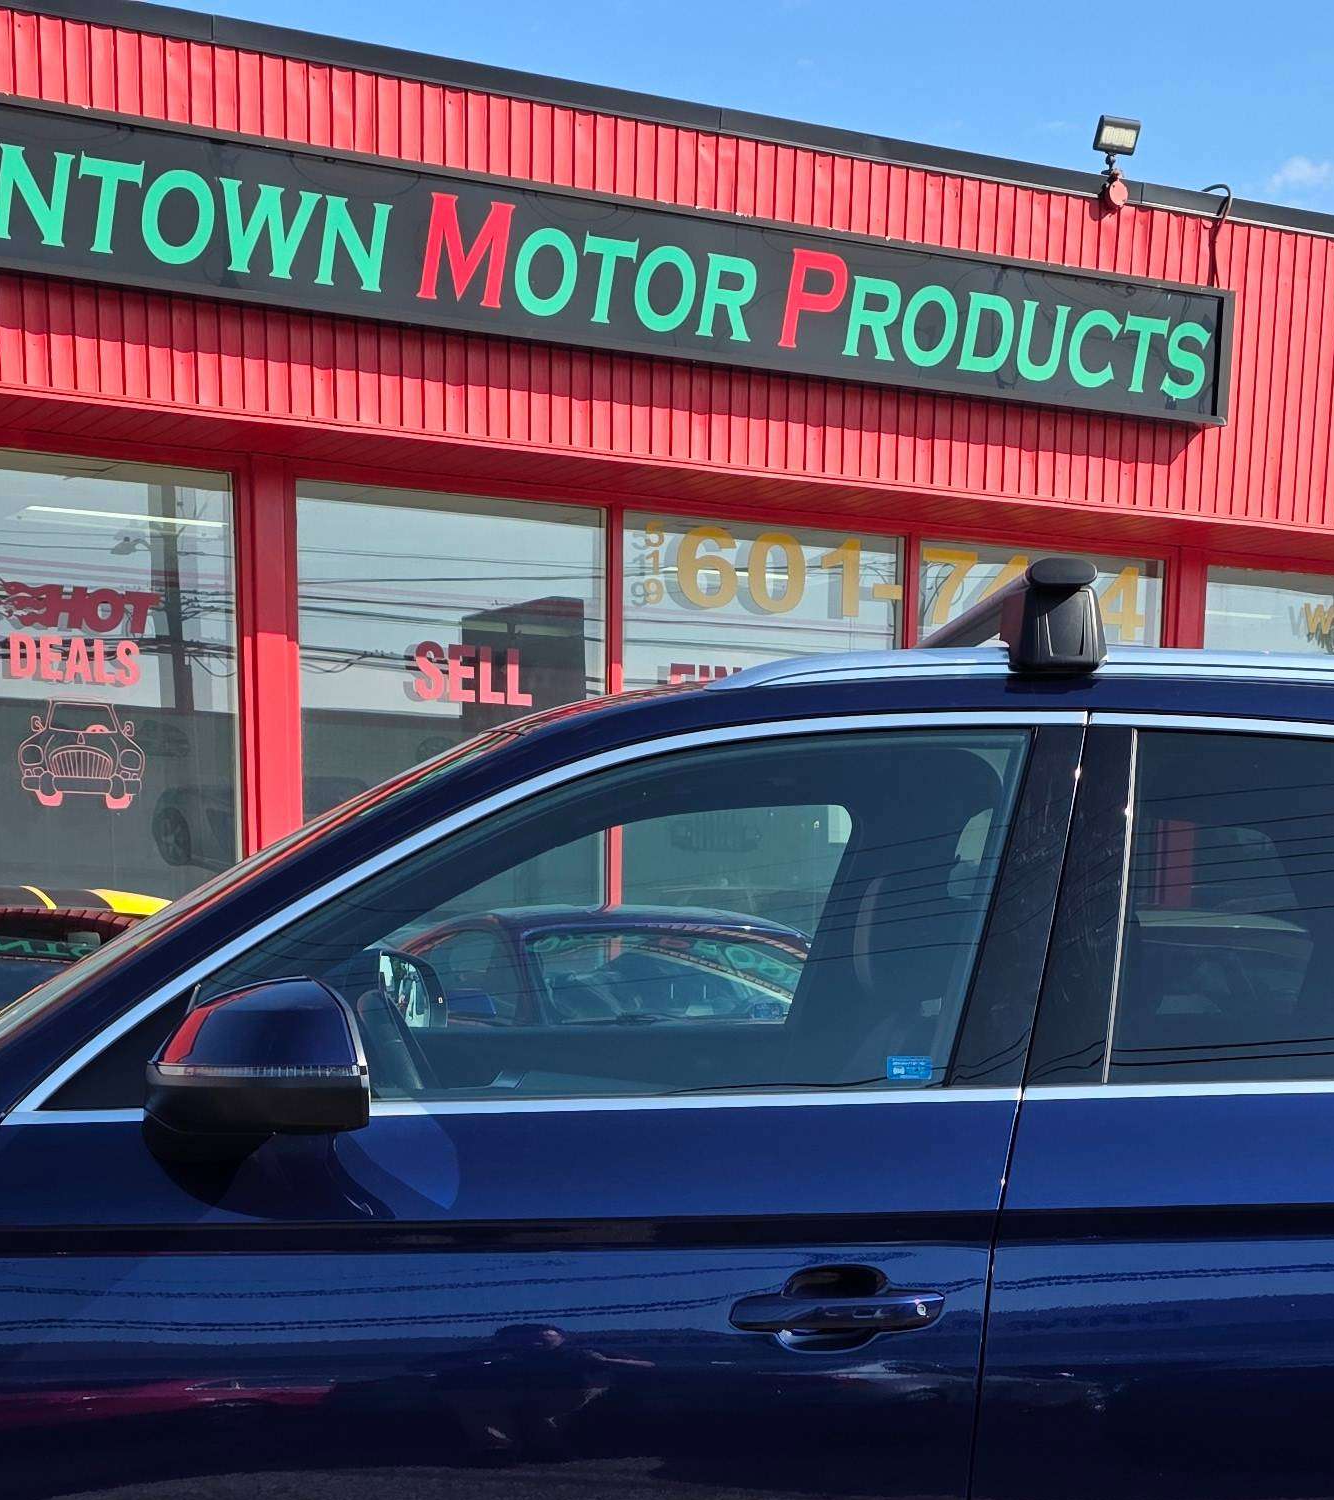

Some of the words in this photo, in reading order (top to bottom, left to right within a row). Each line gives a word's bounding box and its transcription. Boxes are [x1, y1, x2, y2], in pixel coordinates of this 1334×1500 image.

[416, 191, 758, 343] MOTOR
[777, 247, 1212, 400] PRODUCTS
[45, 584, 164, 634] HOT
[675, 525, 1146, 641] 601-74
[8, 632, 141, 687] DEALS
[413, 640, 533, 707] SELL
